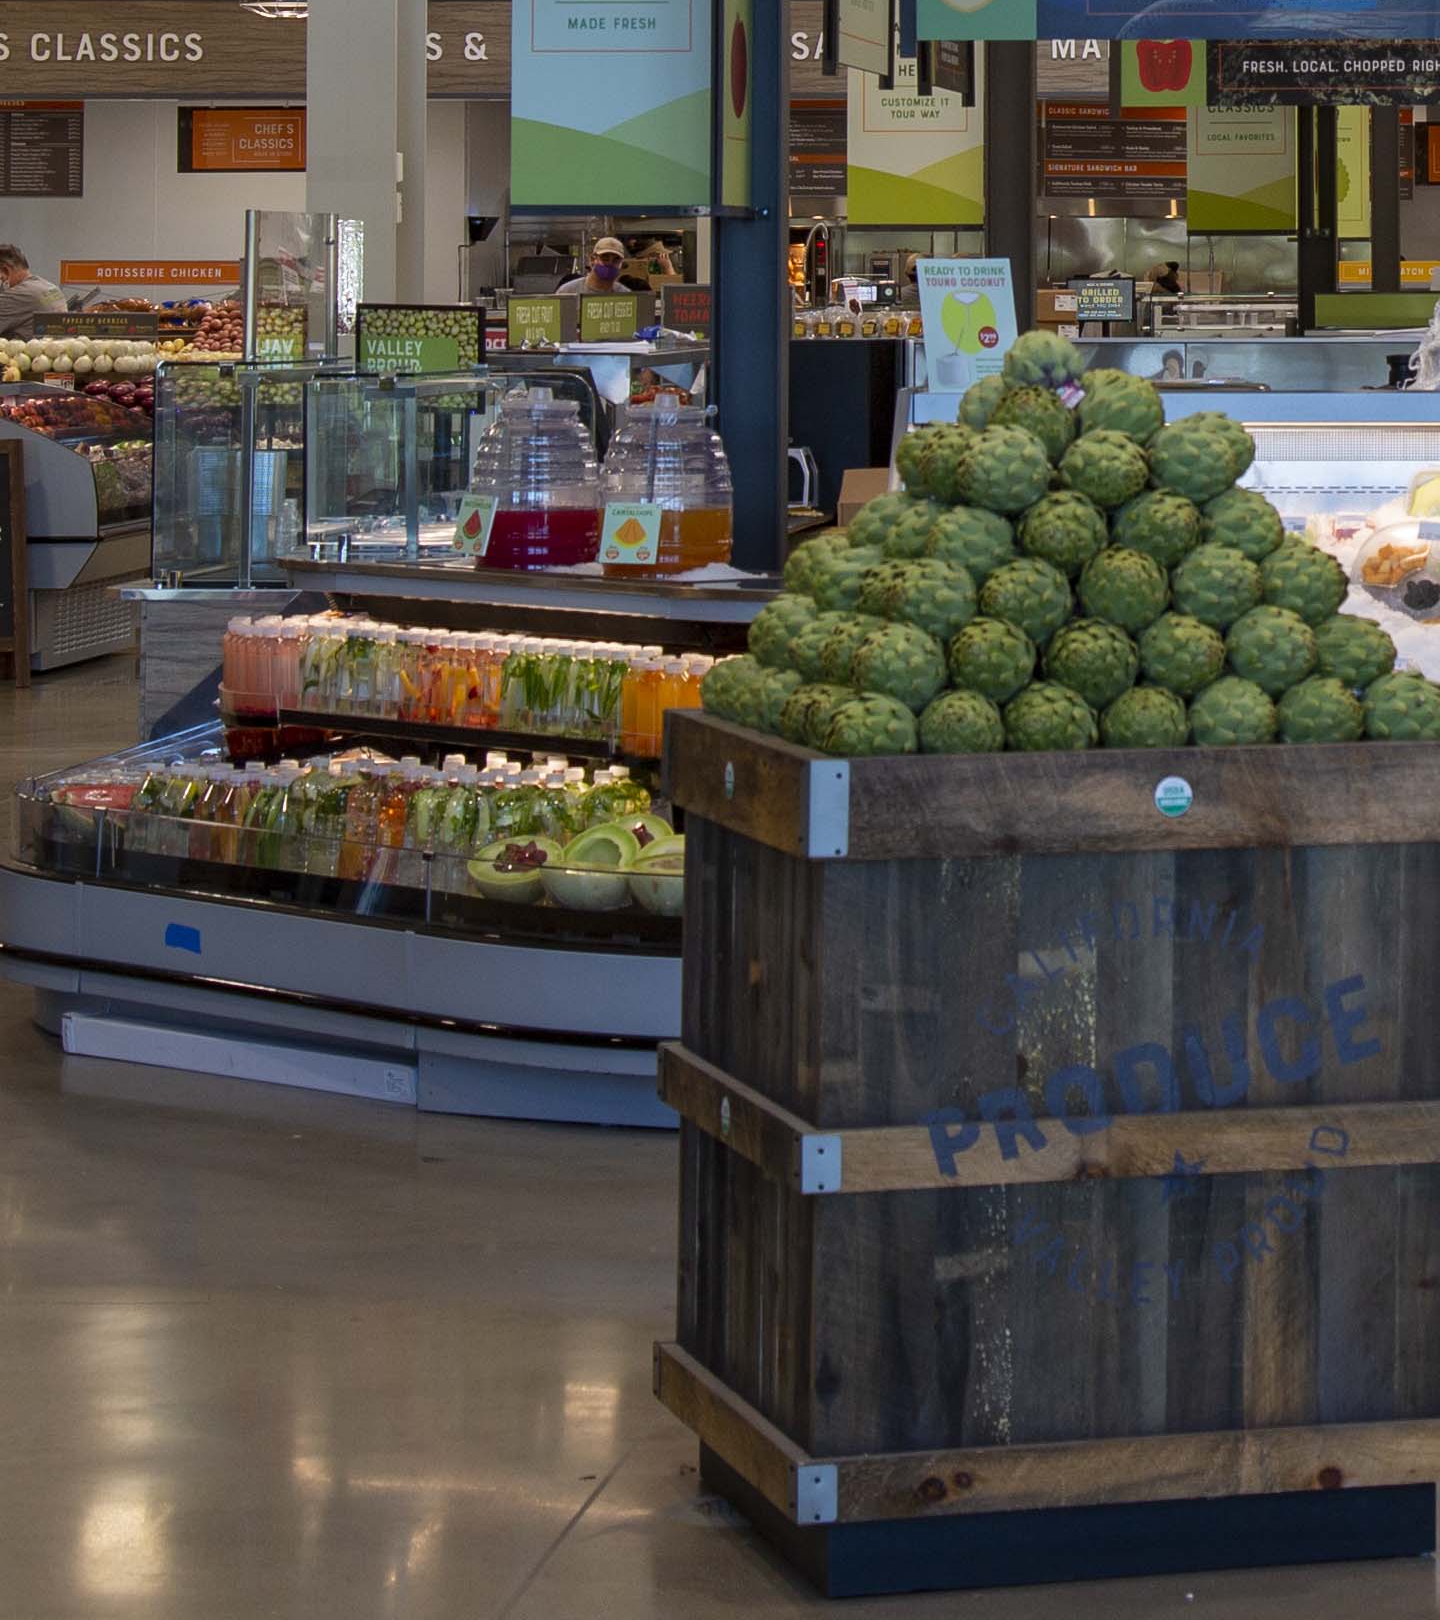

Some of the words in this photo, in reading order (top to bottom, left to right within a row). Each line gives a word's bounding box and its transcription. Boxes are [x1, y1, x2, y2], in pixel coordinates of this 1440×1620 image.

[567, 17, 605, 30] MADE
[613, 17, 657, 30] FRESH
[29, 31, 205, 63] CLASSICS
[1242, 59, 1288, 75] FRESH.
[1293, 59, 1339, 75] LOCAL.
[1344, 59, 1407, 75] CHOPPED
[881, 98, 936, 107] CUSTOMIZE
[941, 98, 950, 106] IT
[891, 111, 915, 119] YOUR
[921, 110, 941, 118] WAY
[239, 138, 294, 149] CLASSICS
[1087, 164, 1122, 172] SANDWICH
[96, 266, 166, 279] ROTISSERIE
[171, 266, 223, 279] CHICKEN
[924, 266, 954, 275] READY
[959, 266, 971, 275] TO
[974, 266, 1005, 275] DRINK
[925, 278, 957, 287] YOUNG
[960, 278, 1005, 286] COCONUT
[366, 340, 423, 357] VALLEY
[975, 896, 1268, 1038] CALIFORNIA
[922, 974, 1384, 1178] PRODUCE
[1011, 1206, 1190, 1309] VALLEY
[1212, 1124, 1351, 1285] PROUD
